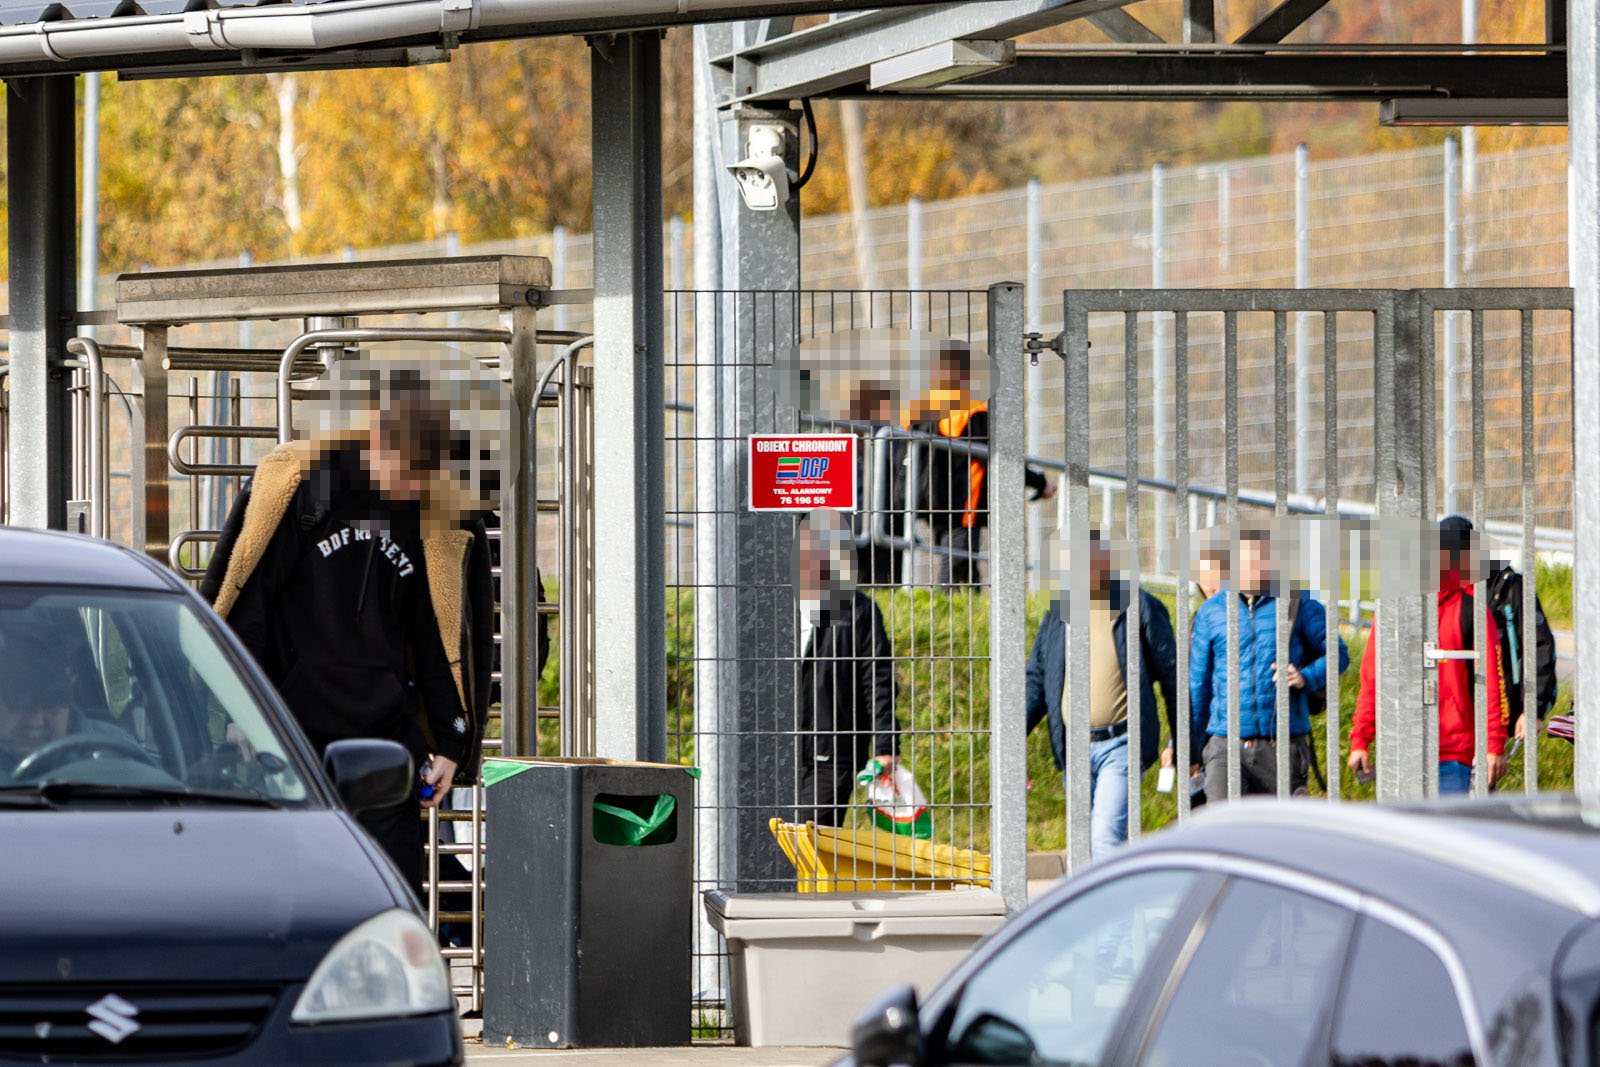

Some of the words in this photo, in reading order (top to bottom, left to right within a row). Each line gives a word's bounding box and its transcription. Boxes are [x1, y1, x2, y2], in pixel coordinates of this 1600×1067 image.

[756, 440, 790, 453] OBIEKT
[792, 440, 848, 453] CHRONIONY
[800, 456, 830, 479] DGP
[790, 487, 833, 495] ALARMOWY
[780, 496, 792, 505] 76
[794, 496, 811, 505] 196
[813, 496, 826, 505] 55
